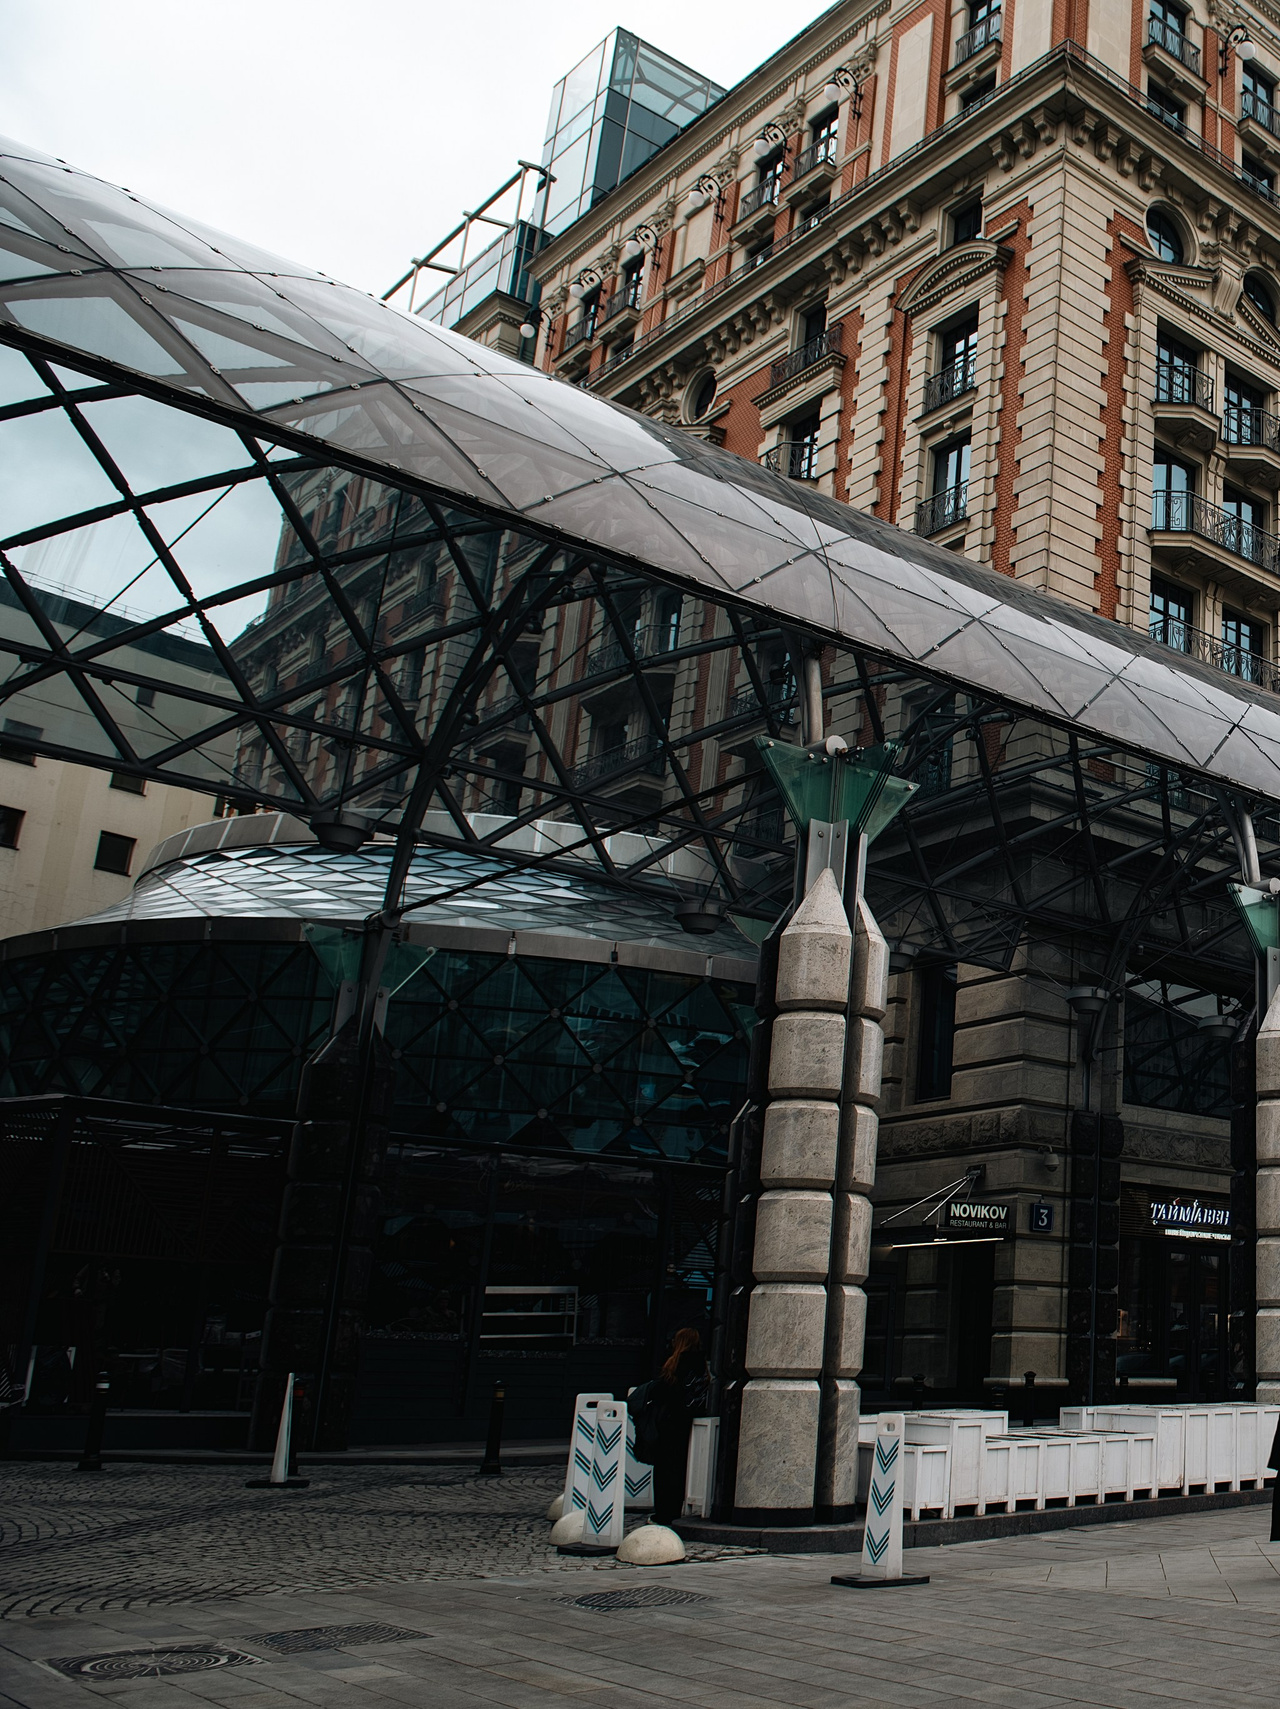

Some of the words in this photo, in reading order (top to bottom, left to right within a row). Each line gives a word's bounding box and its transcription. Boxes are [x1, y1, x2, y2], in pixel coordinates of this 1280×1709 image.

[950, 1203, 1008, 1220] NOVIKOV
[1038, 1209, 1049, 1226] 3
[1193, 1207, 1230, 1226] АВЕН
[949, 1219, 988, 1228] RESTAURANT
